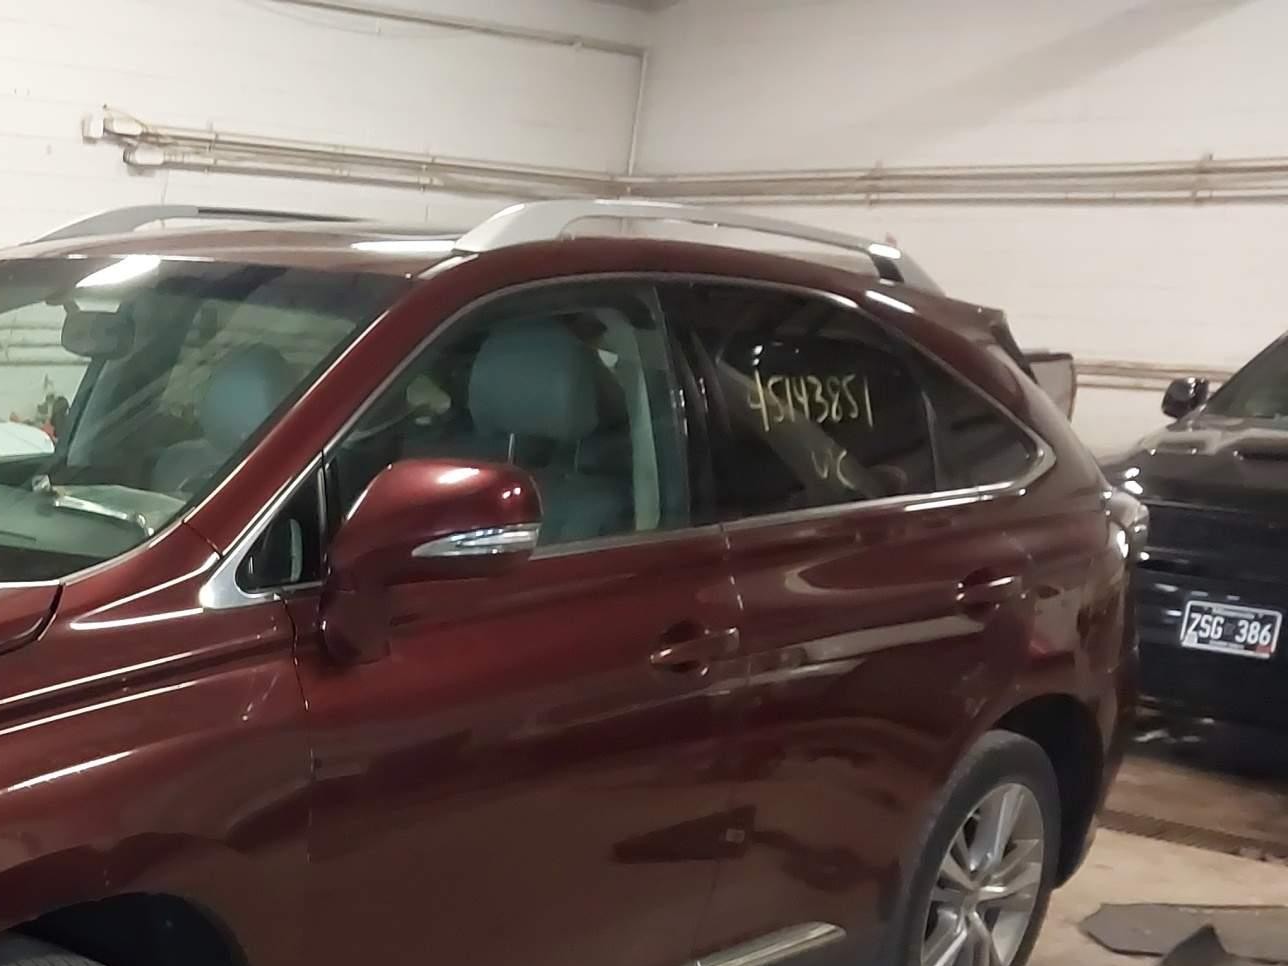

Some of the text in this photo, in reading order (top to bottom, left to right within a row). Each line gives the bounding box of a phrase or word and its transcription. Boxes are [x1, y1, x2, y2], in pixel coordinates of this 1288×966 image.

[748, 369, 873, 432] 45143851
[1185, 613, 1225, 640] ZSG
[1235, 619, 1273, 646] 386
